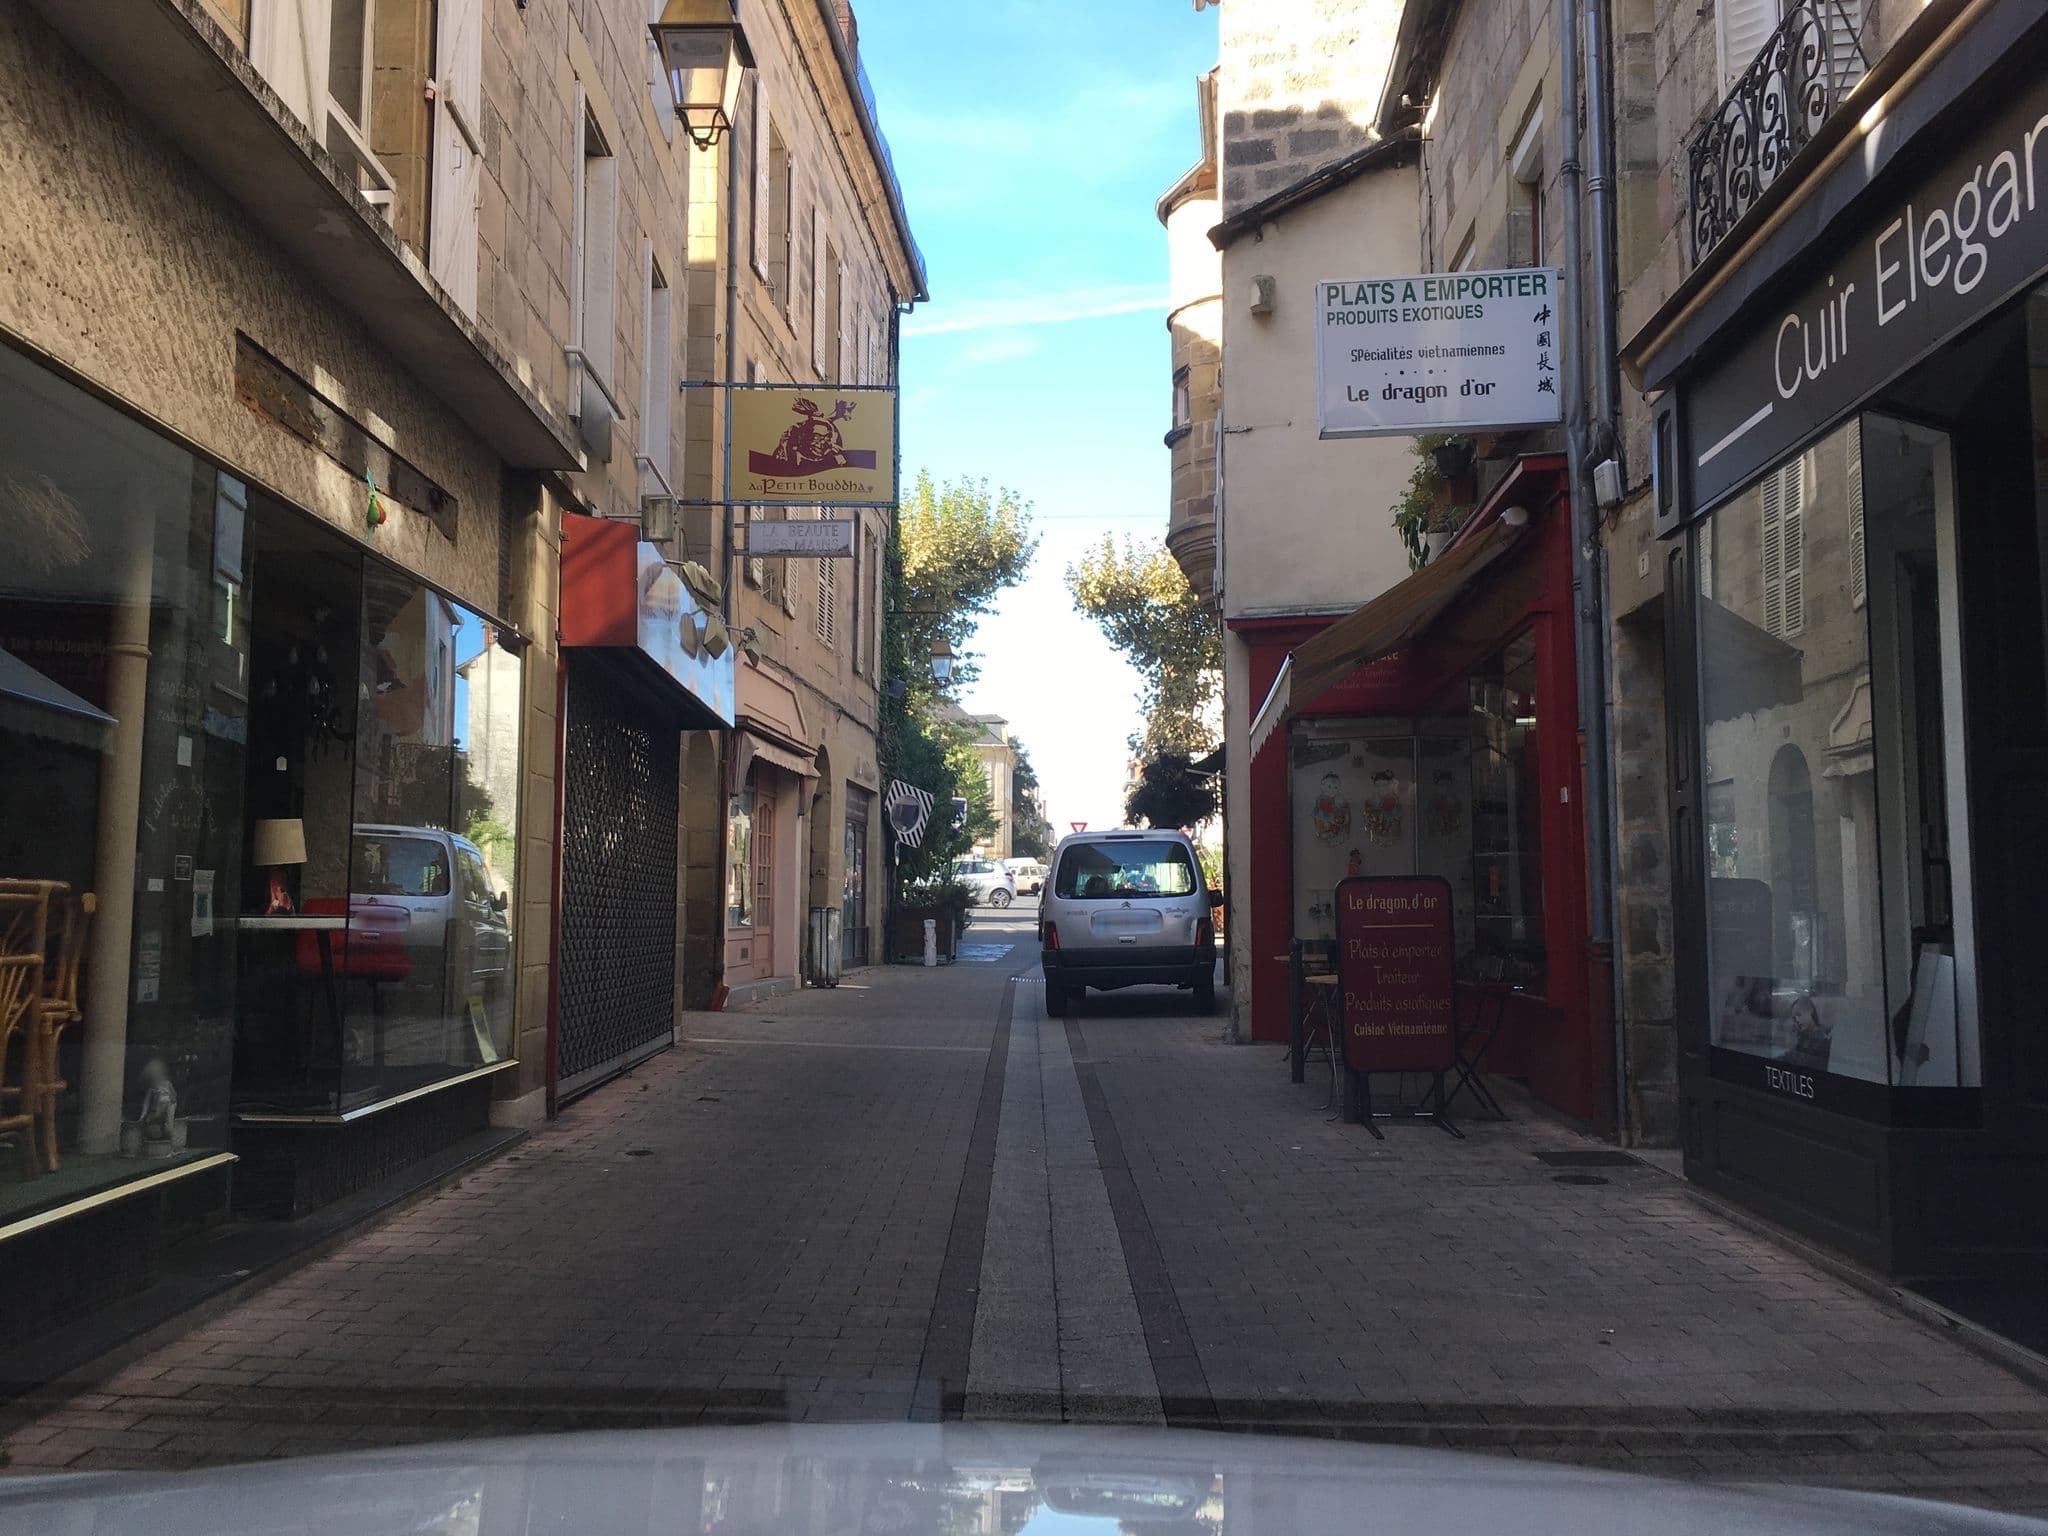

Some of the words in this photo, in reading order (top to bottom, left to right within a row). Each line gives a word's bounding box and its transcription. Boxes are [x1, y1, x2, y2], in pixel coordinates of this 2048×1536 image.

[1327, 281, 1395, 306] PLATS
[1402, 281, 1417, 303] A
[1424, 274, 1547, 301] EMPORTER
[1327, 309, 1398, 325] PRODUITS
[1403, 304, 1483, 322] EXOTIQUES
[1775, 274, 1855, 399] Cuir
[1418, 344, 1505, 358] vietnamiennes
[1347, 385, 1369, 402] Le
[1382, 383, 1448, 403] dragon
[1460, 378, 1496, 396] d'or
[762, 525, 777, 537] LA
[788, 525, 839, 537] BEAUTE
[1349, 893, 1363, 910] Le
[1348, 938, 1379, 959] Plats
[1392, 942, 1441, 966] emporter
[1345, 992, 1392, 1011] Produits
[1396, 993, 1451, 1014] asiatiques
[1354, 1023, 1384, 1036] Cuisine
[1388, 1022, 1448, 1035] Vietnamienne
[1765, 1065, 1815, 1098] TEXTILES
